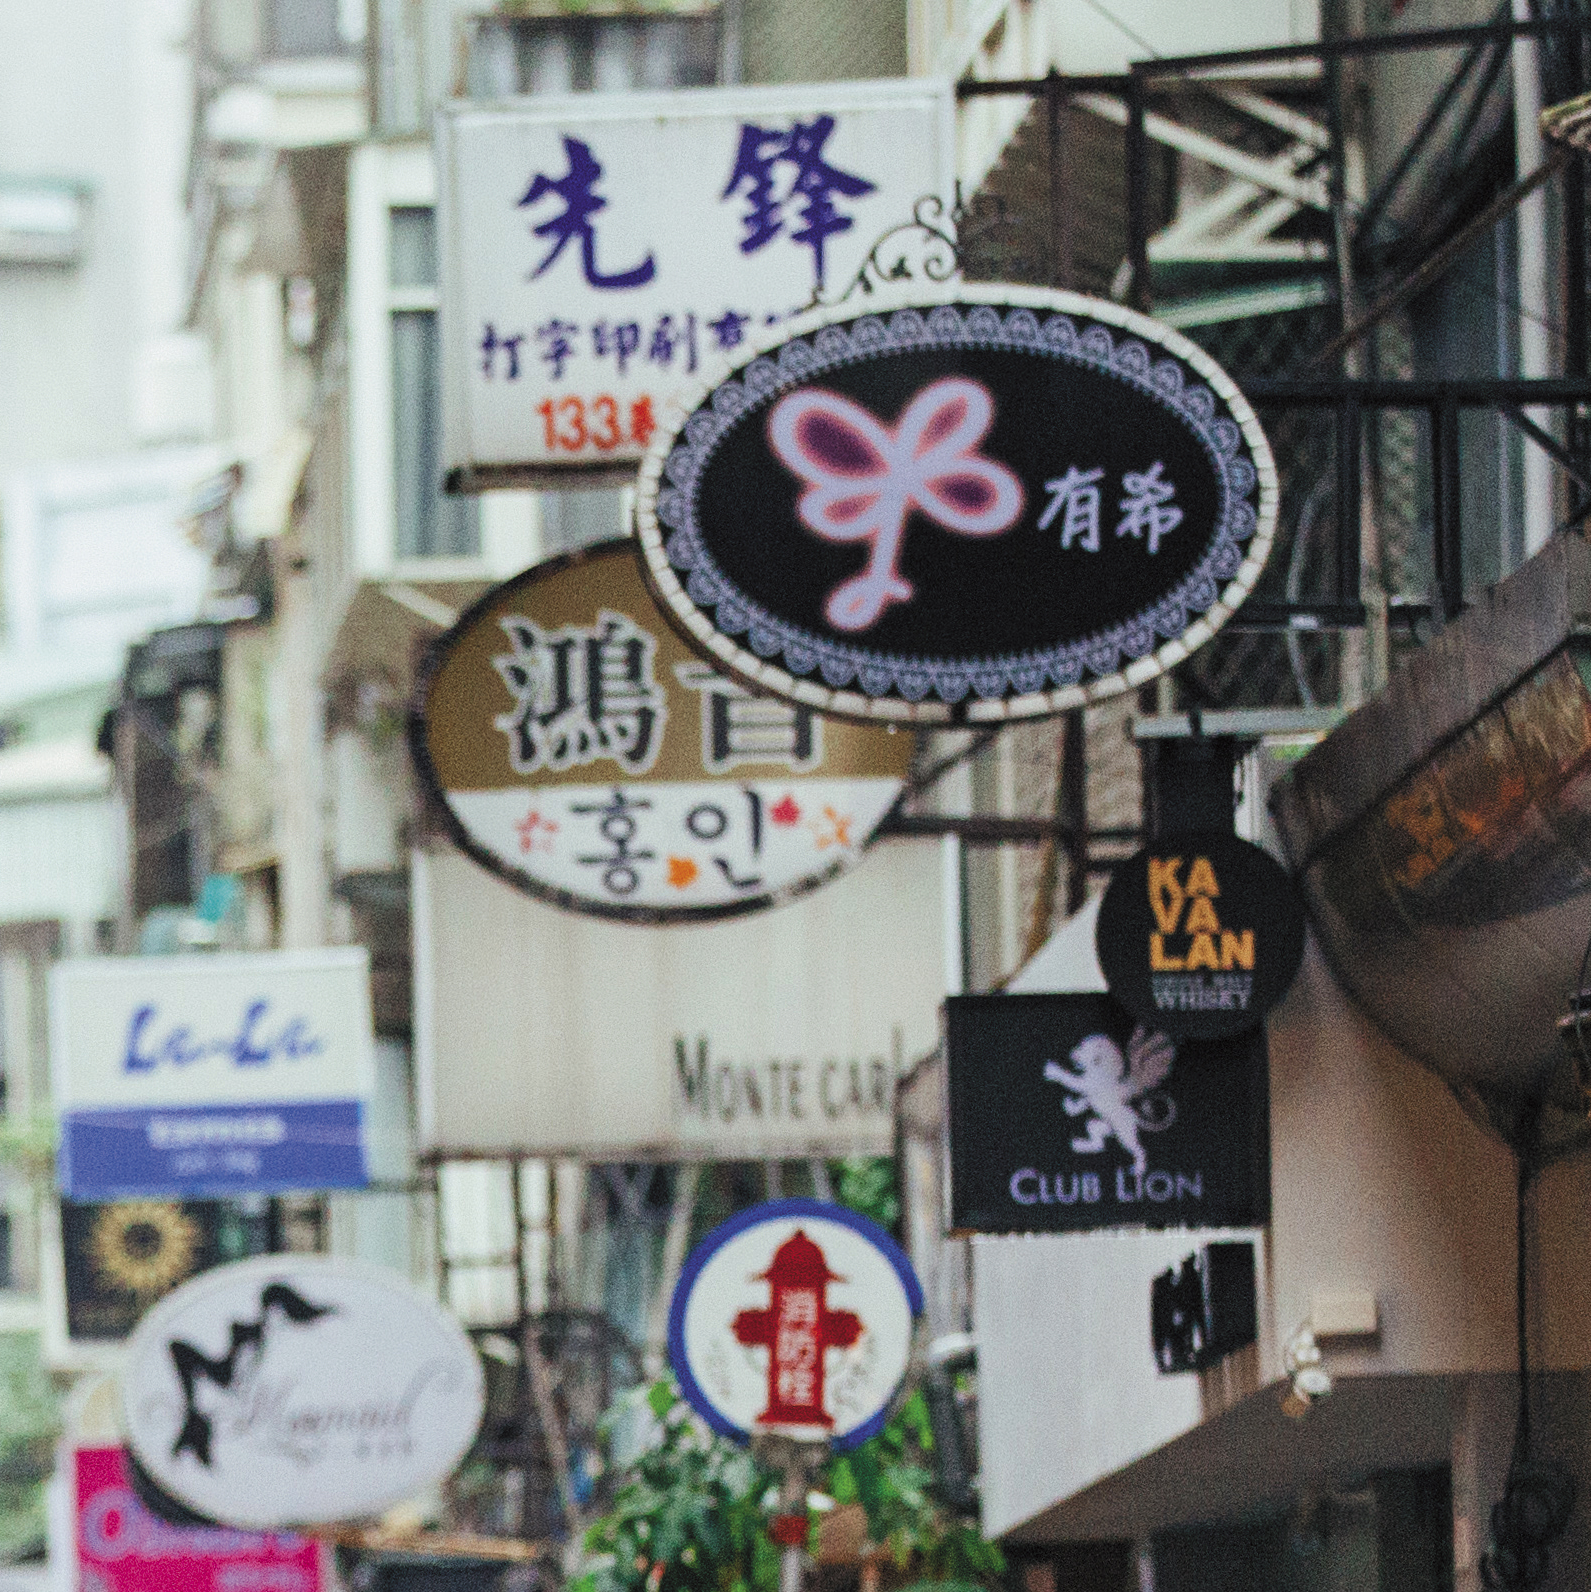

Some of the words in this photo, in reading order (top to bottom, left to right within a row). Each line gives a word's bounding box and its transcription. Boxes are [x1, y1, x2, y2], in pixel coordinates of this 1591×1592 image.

[517, 112, 879, 292] 先鋒
[1036, 460, 1186, 556] 有希
[571, 783, 765, 894] 홍인
[1148, 856, 1221, 897] KA
[1150, 894, 1222, 935] VA
[1149, 928, 1255, 971] LAN
[673, 1033, 804, 1121] MONTE
[1008, 1166, 1102, 1204] CLUB
[1116, 1168, 1204, 1203] LION
